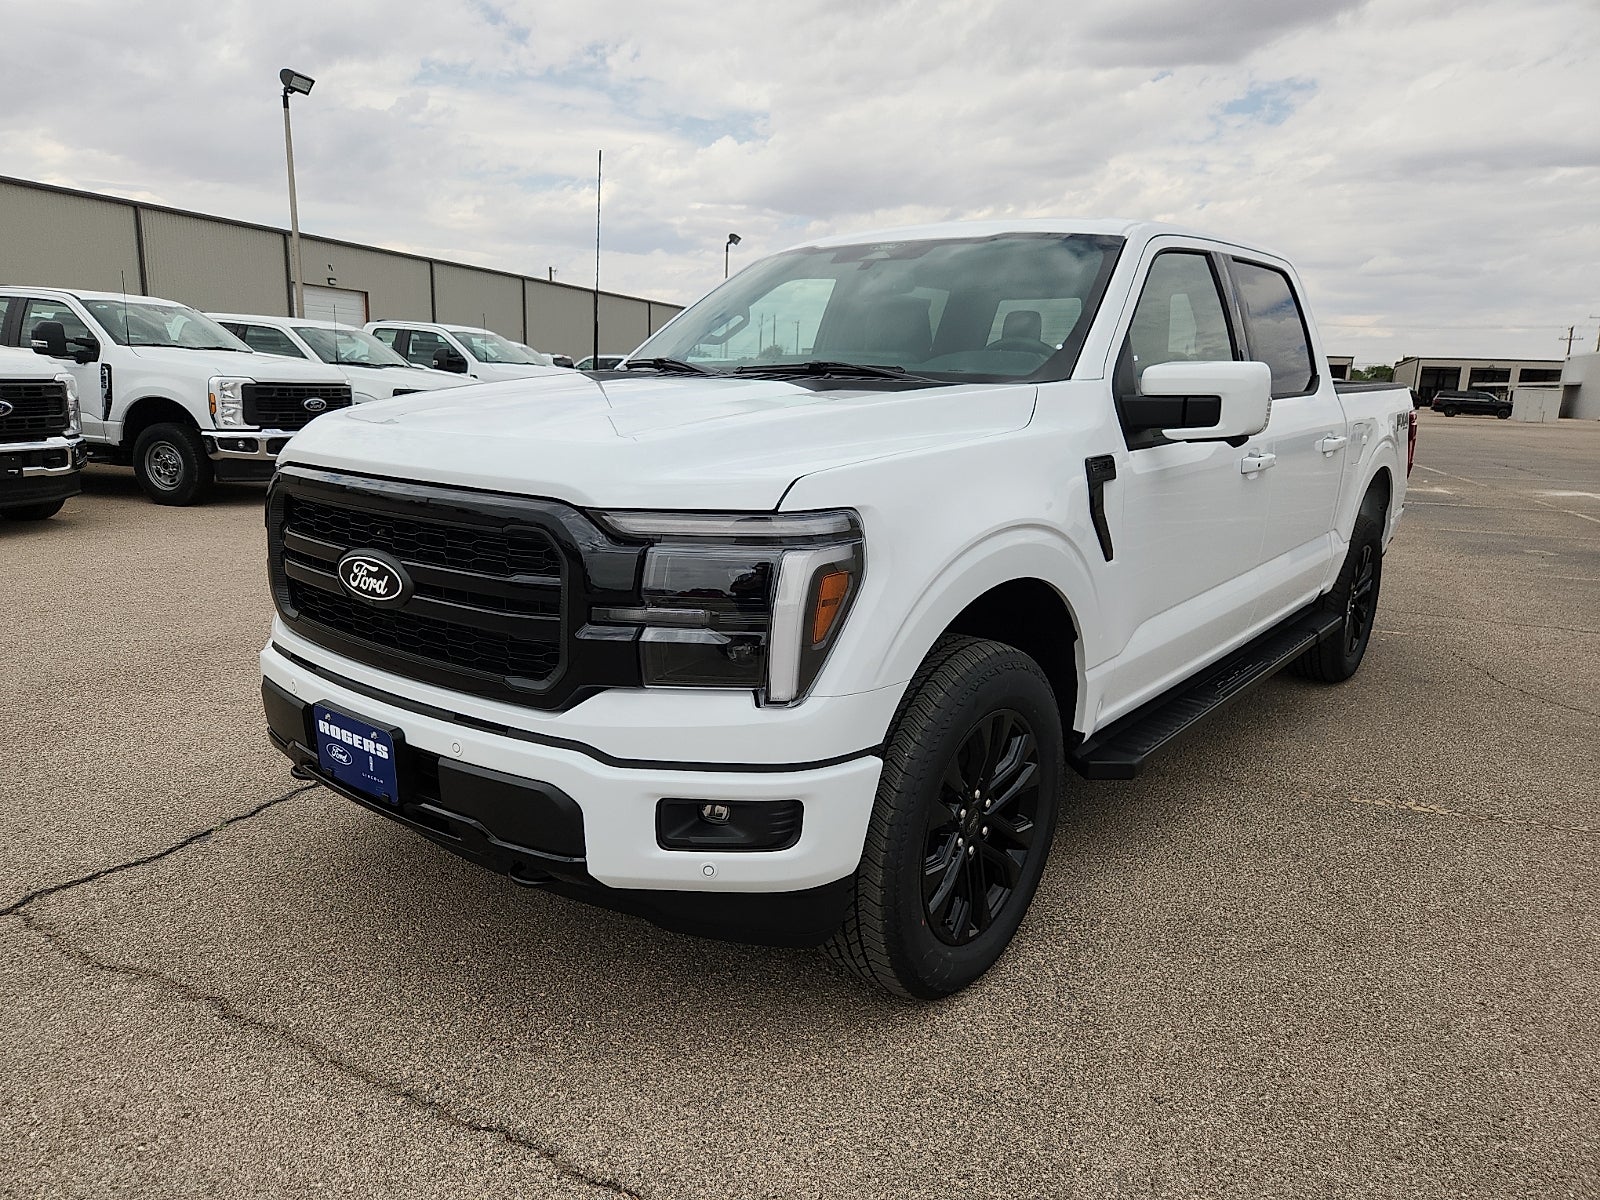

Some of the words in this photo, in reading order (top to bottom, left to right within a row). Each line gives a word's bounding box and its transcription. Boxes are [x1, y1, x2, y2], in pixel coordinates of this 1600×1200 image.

[350, 561, 389, 595] Ford
[318, 719, 389, 759] ROGERS
[331, 745, 348, 763] Ford
